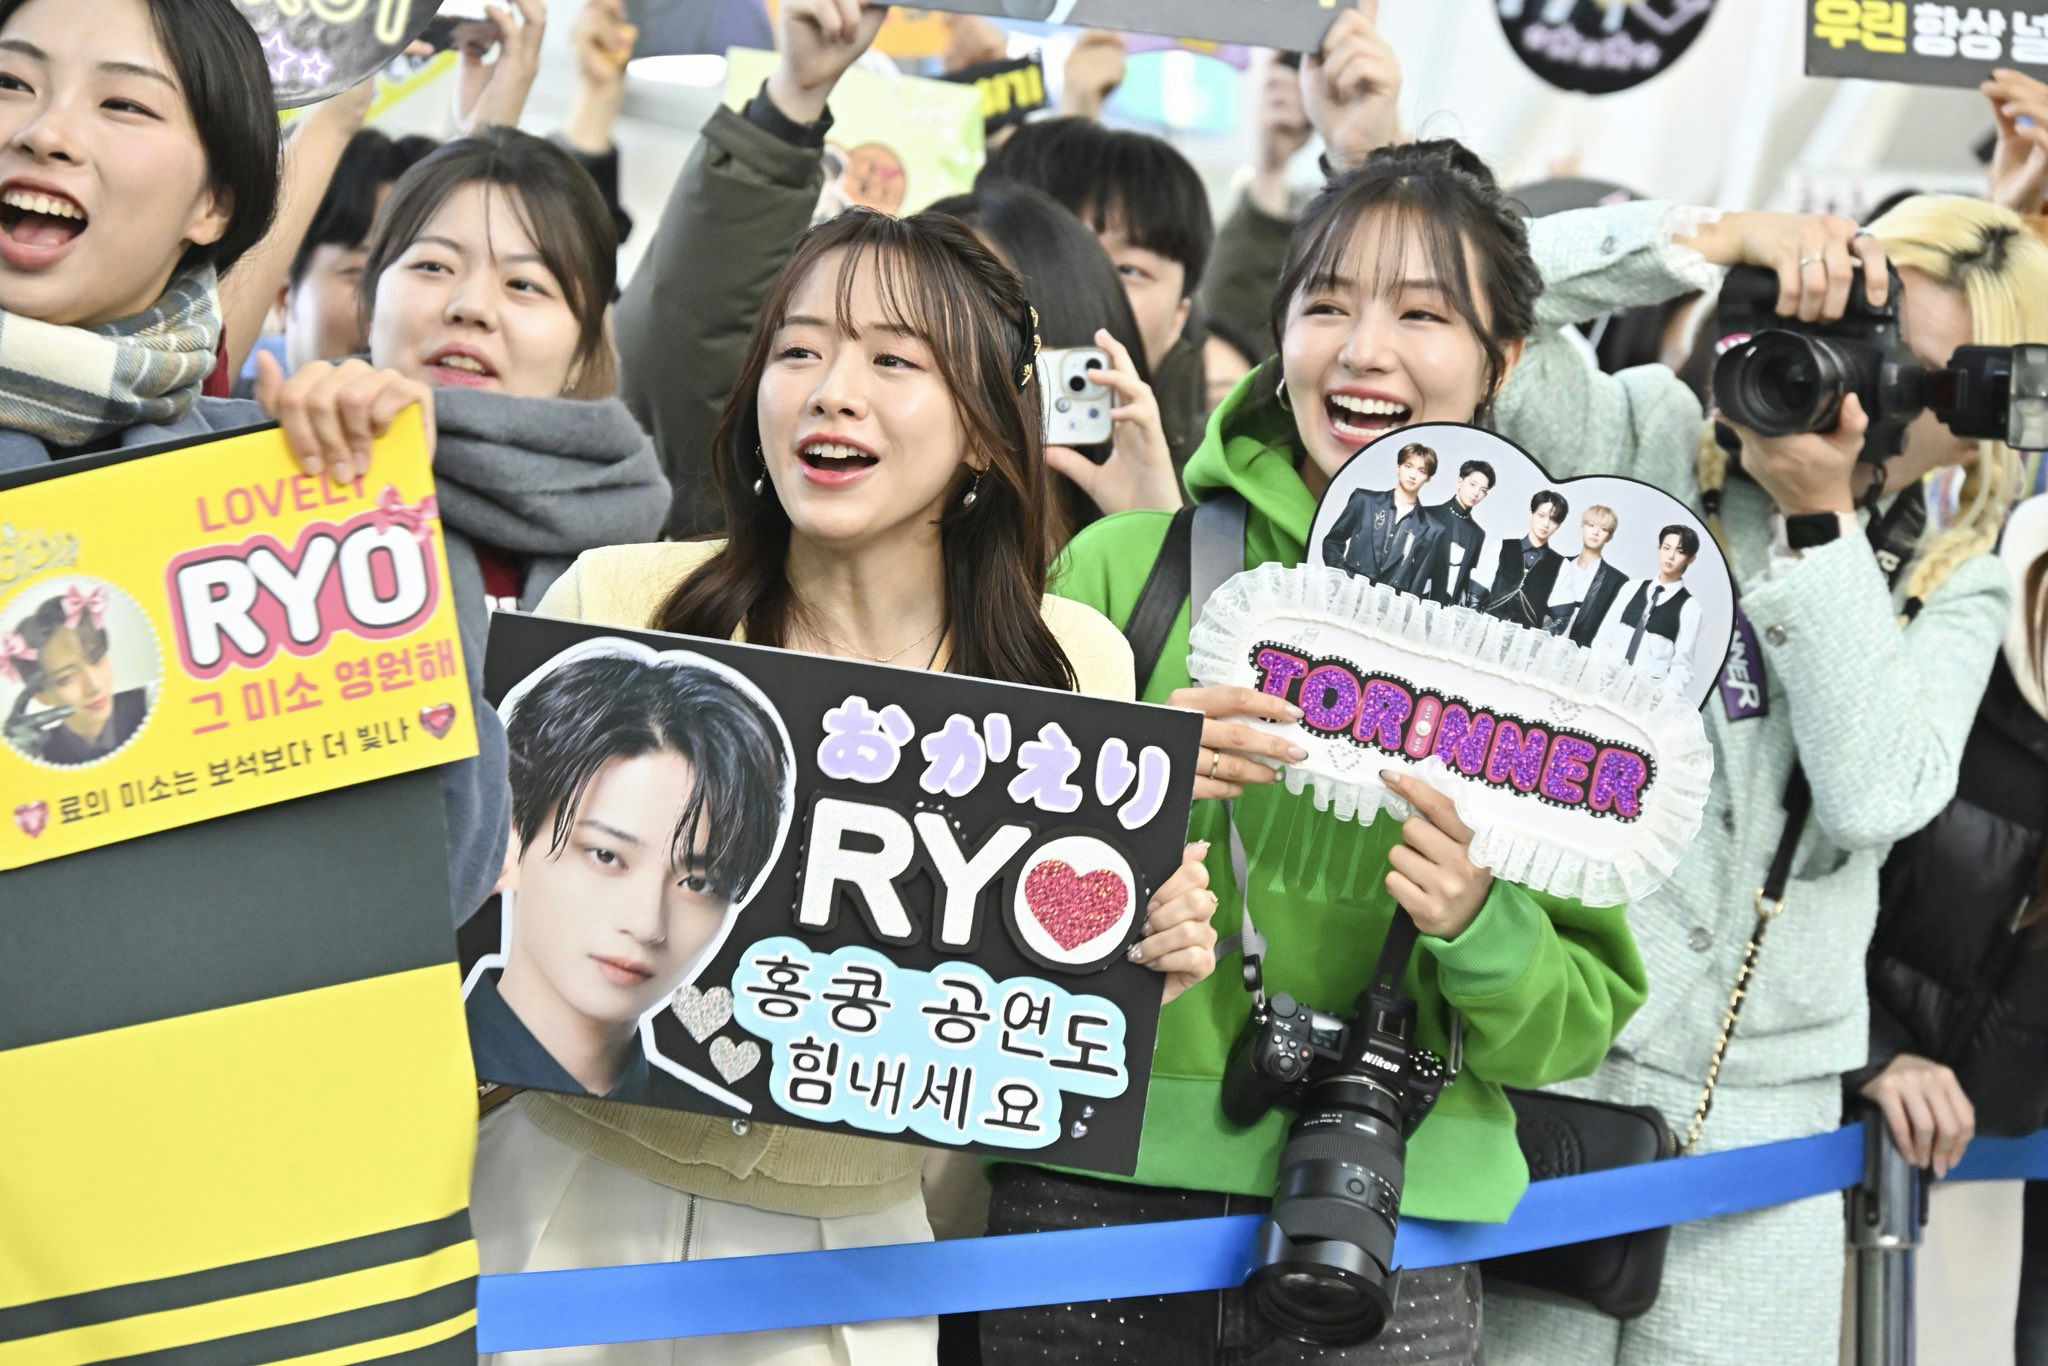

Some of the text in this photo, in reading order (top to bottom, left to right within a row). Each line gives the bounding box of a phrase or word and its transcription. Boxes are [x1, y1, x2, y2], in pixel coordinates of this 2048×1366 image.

[1813, 0, 1907, 53] 우린
[1913, 2, 2006, 61] 항상
[178, 521, 428, 668] RYO
[188, 639, 459, 736] 그 미소 영원해
[1257, 648, 1647, 820] TORINNER
[59, 716, 410, 825] 료의 미소는 보석보다 더 빛나
[817, 695, 1171, 829] おかえり
[747, 955, 1120, 1079] 홍콩 공연도
[1361, 1052, 1401, 1073] Nikon
[786, 1036, 1042, 1134] 힘내세요
